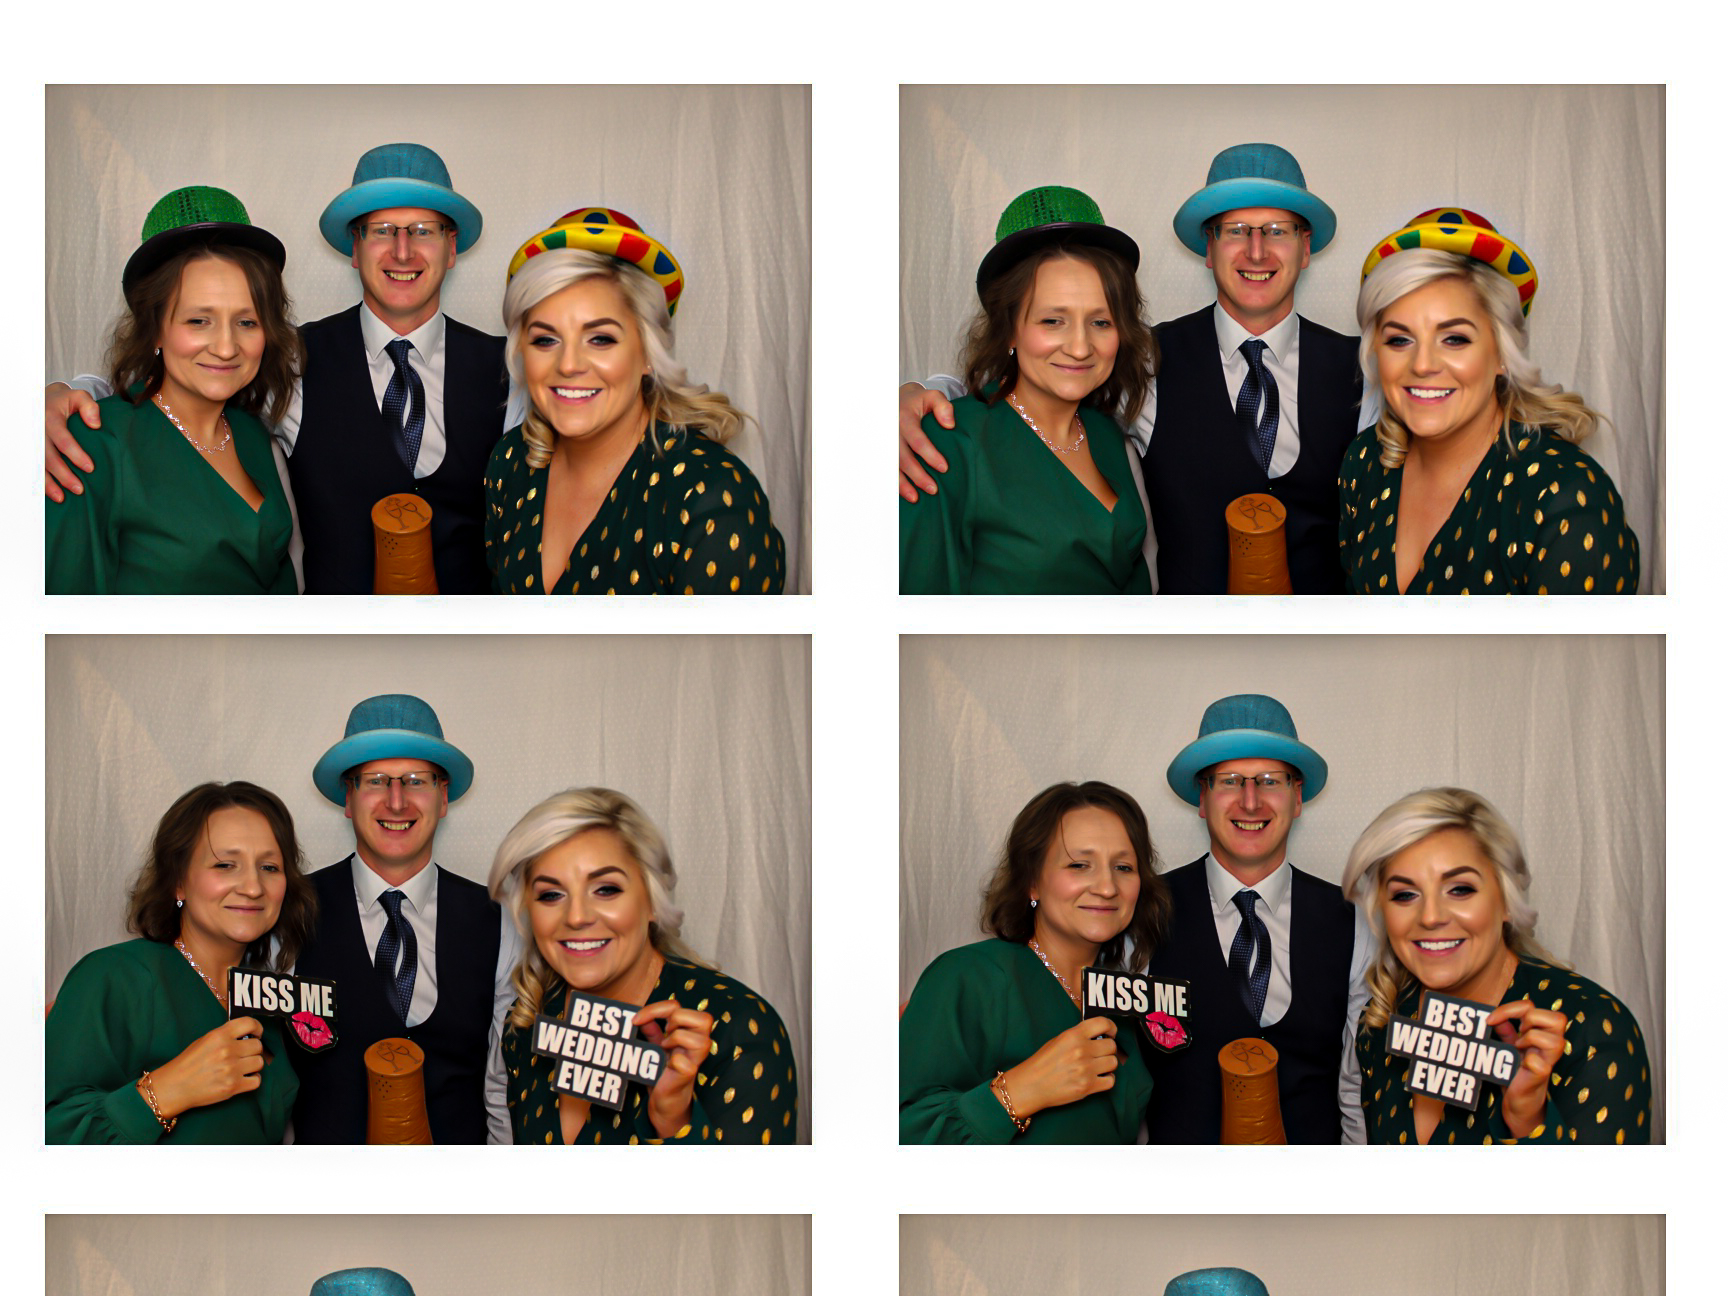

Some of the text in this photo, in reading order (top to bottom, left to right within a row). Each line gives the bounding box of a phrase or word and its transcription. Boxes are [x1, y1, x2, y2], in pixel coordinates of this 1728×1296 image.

[234, 972, 334, 1017] KISS ME
[1088, 972, 1188, 1017] KISS ME
[570, 998, 637, 1040] BEST
[1424, 998, 1491, 1040] BEST
[537, 1021, 660, 1081] WEDDING
[1391, 1021, 1514, 1081] WEDDING
[556, 1060, 622, 1104] EVER
[1410, 1060, 1476, 1104] EVER
